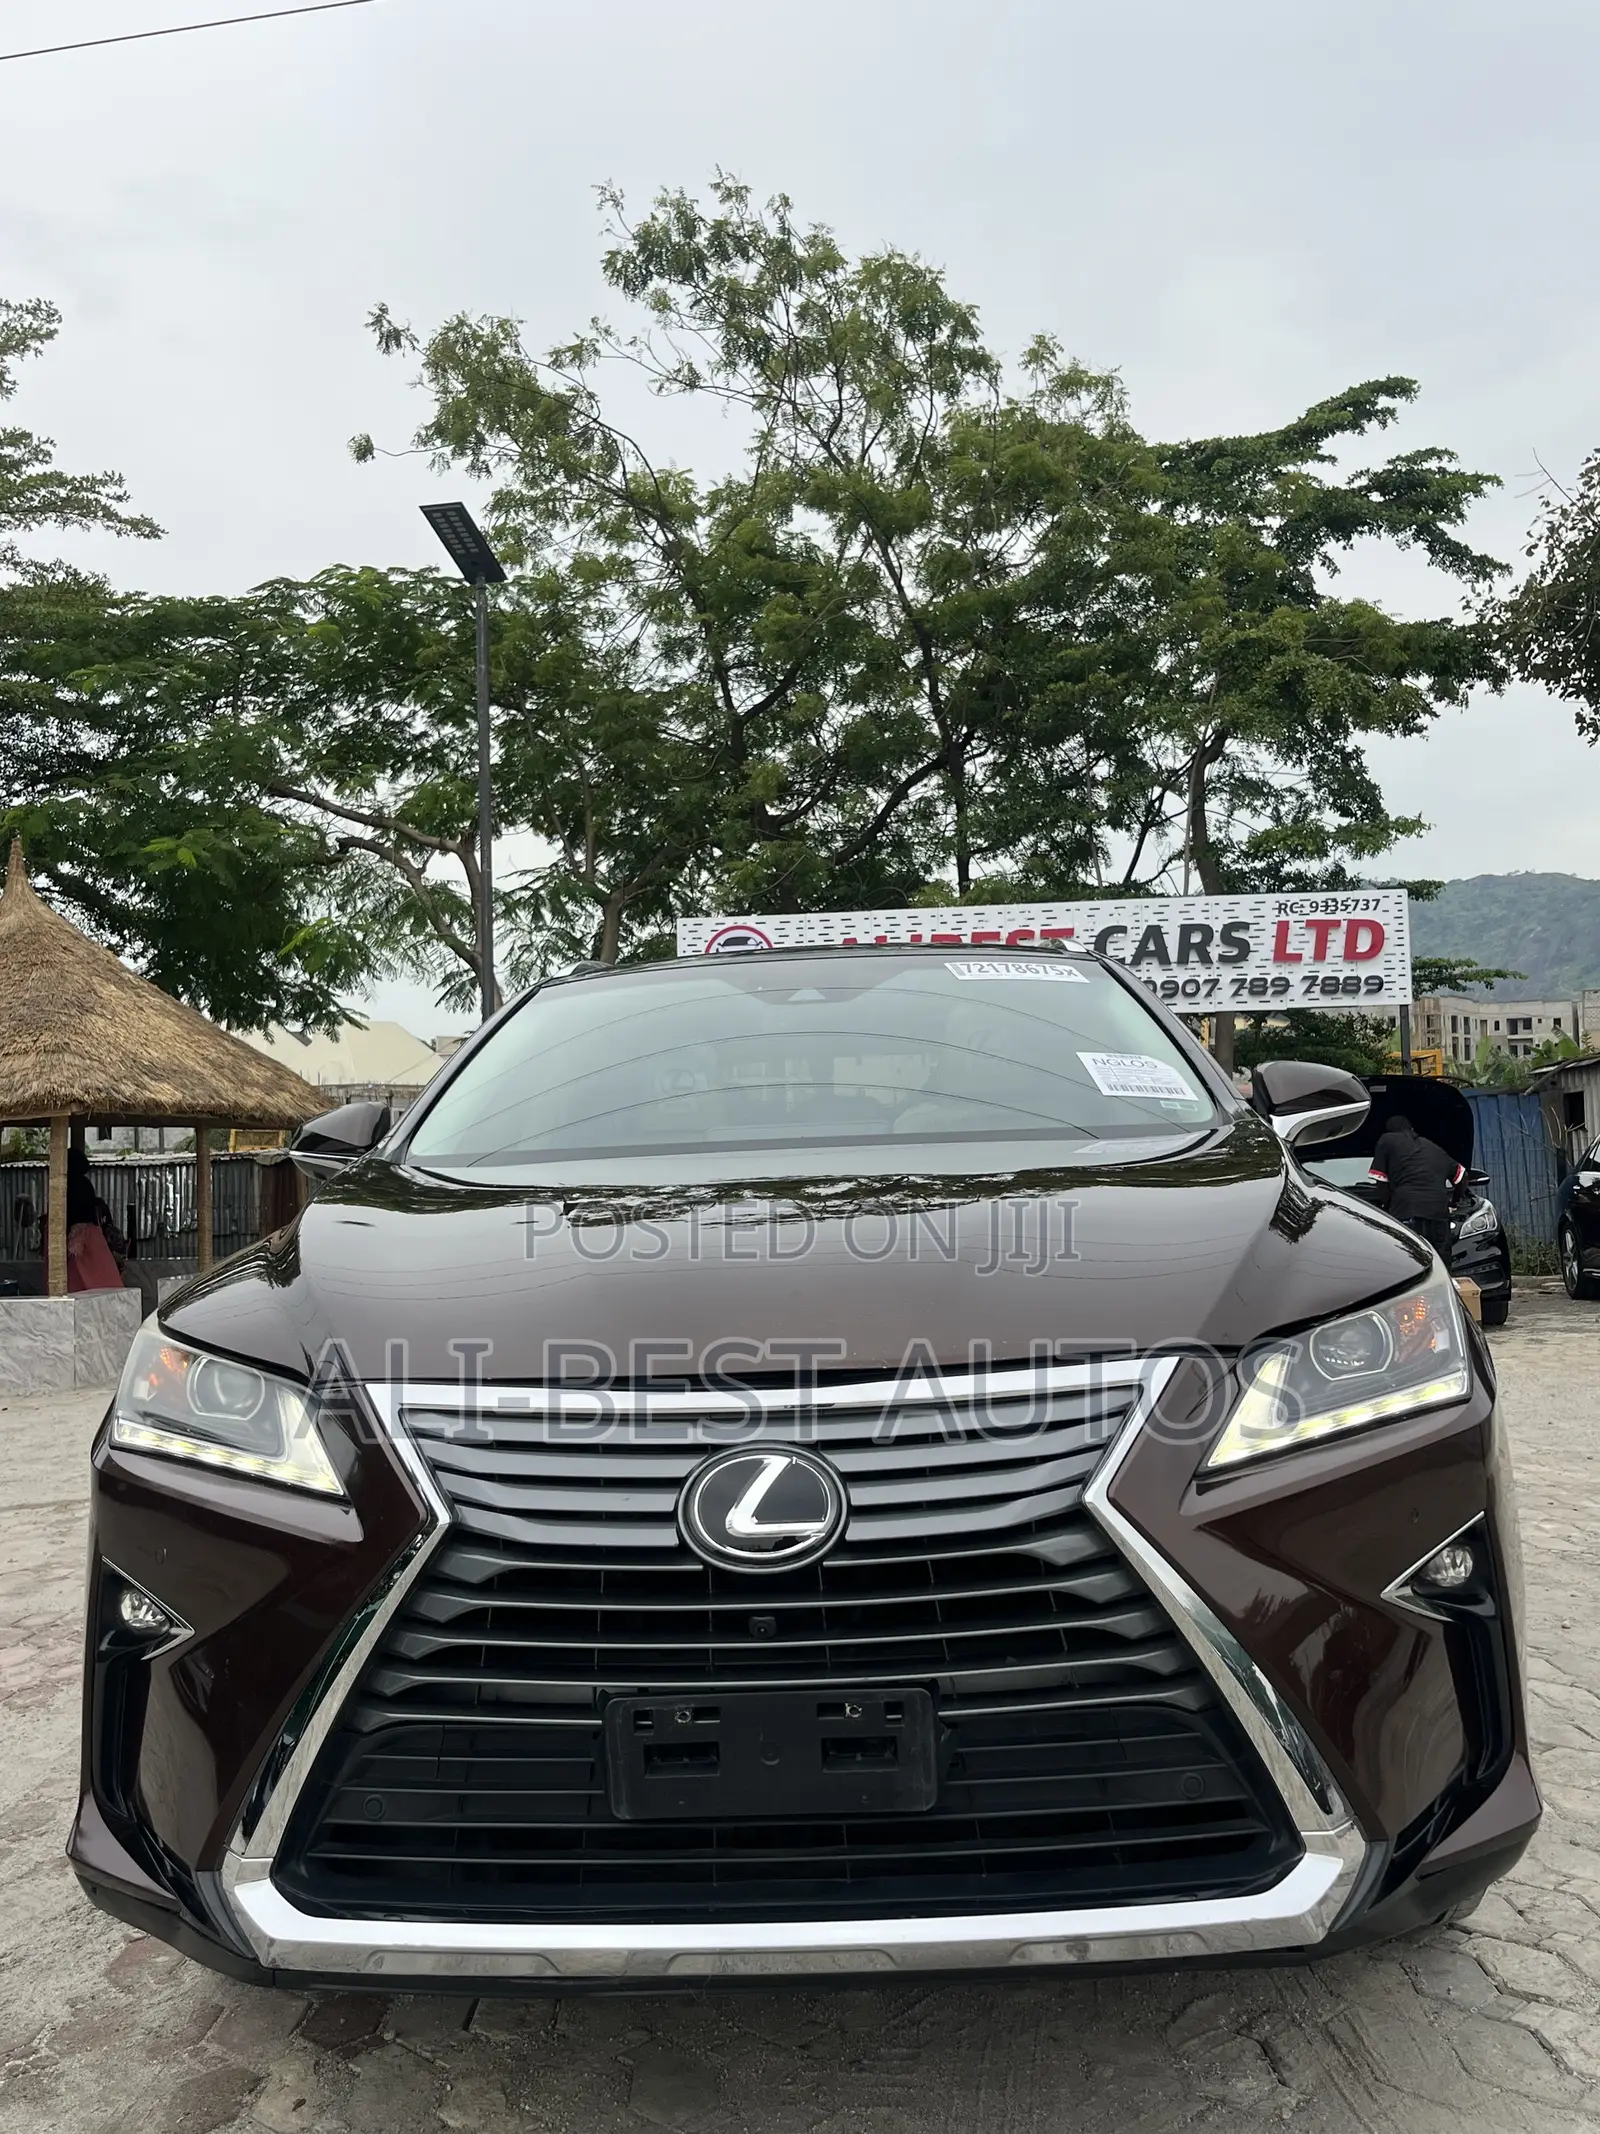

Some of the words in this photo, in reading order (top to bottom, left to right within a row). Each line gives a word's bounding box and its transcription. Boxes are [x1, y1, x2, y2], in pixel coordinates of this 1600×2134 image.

[1094, 921, 1251, 966] CARS
[1273, 919, 1385, 963] LTD
[1229, 976, 1290, 998] 789
[1300, 974, 1384, 996] 7889
[1092, 1058, 1157, 1069] NGLOS
